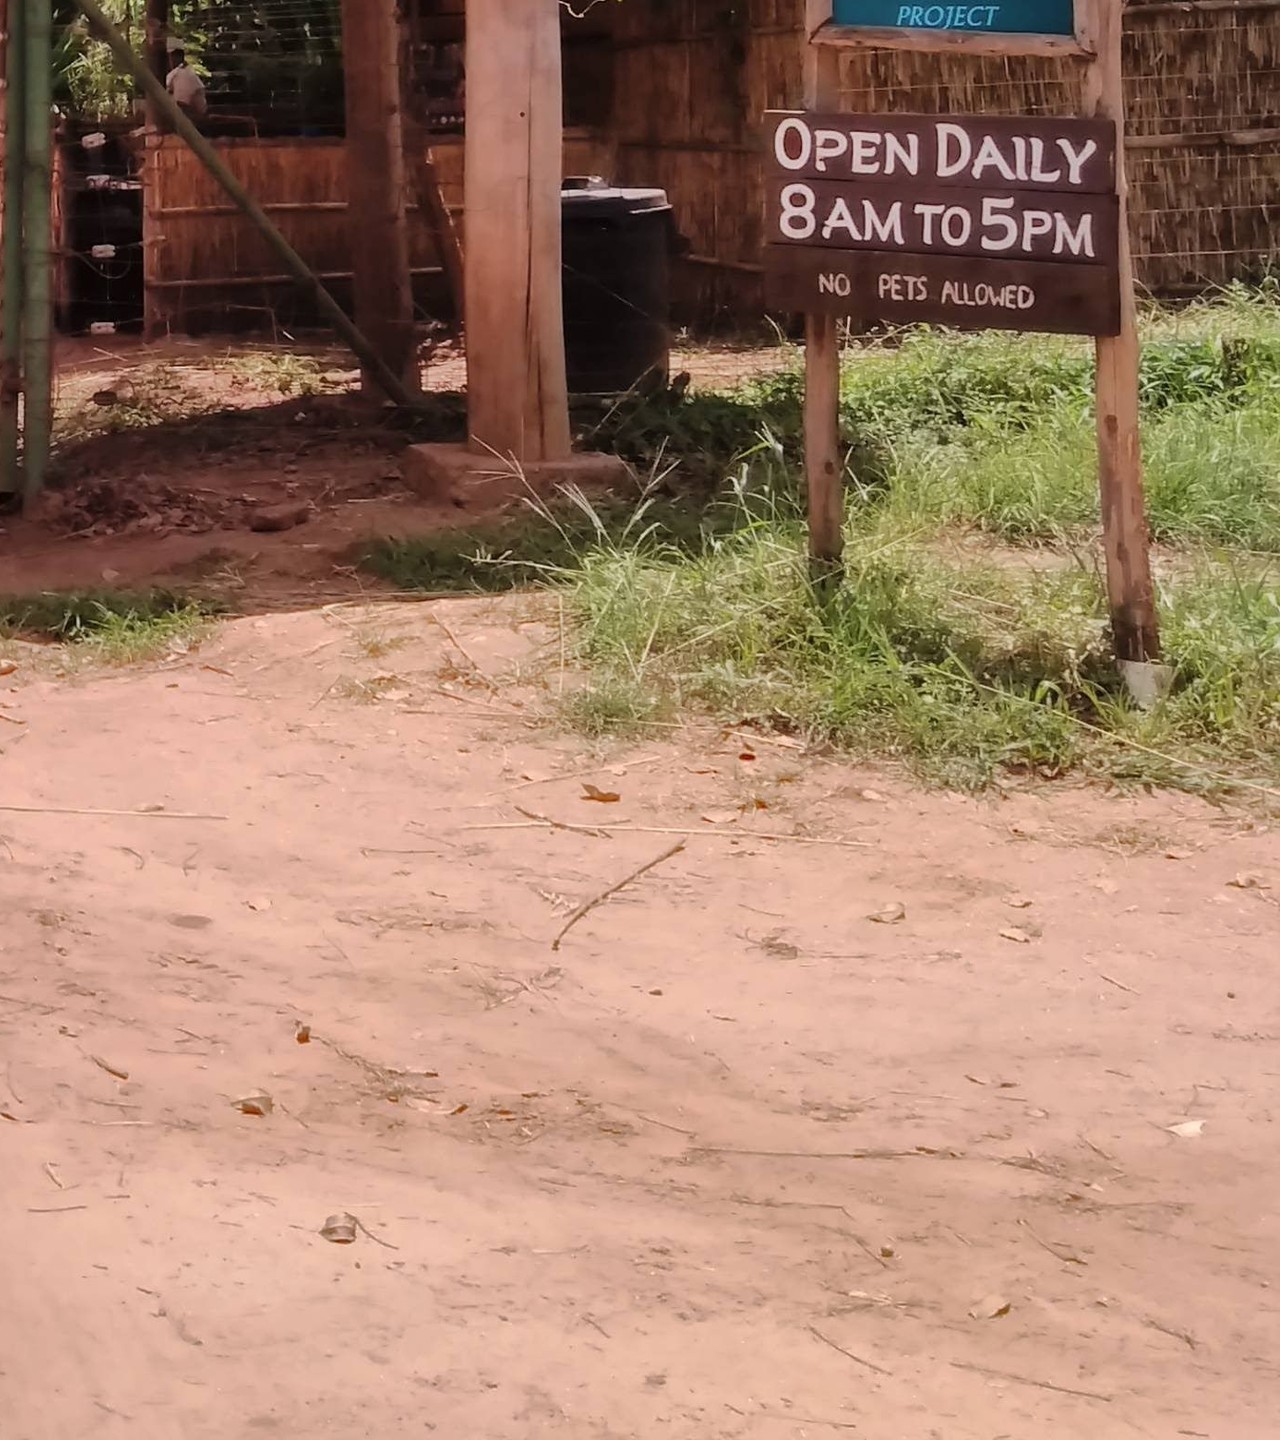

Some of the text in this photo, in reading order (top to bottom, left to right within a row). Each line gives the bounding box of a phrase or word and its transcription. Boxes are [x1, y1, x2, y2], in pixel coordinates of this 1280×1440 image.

[895, 5, 1000, 29] PROJECT
[773, 117, 1097, 185] OPEN DAILY
[913, 202, 972, 248] TO
[979, 197, 1095, 259] 5PM
[818, 272, 1036, 311] NO PETS ALLOWED
